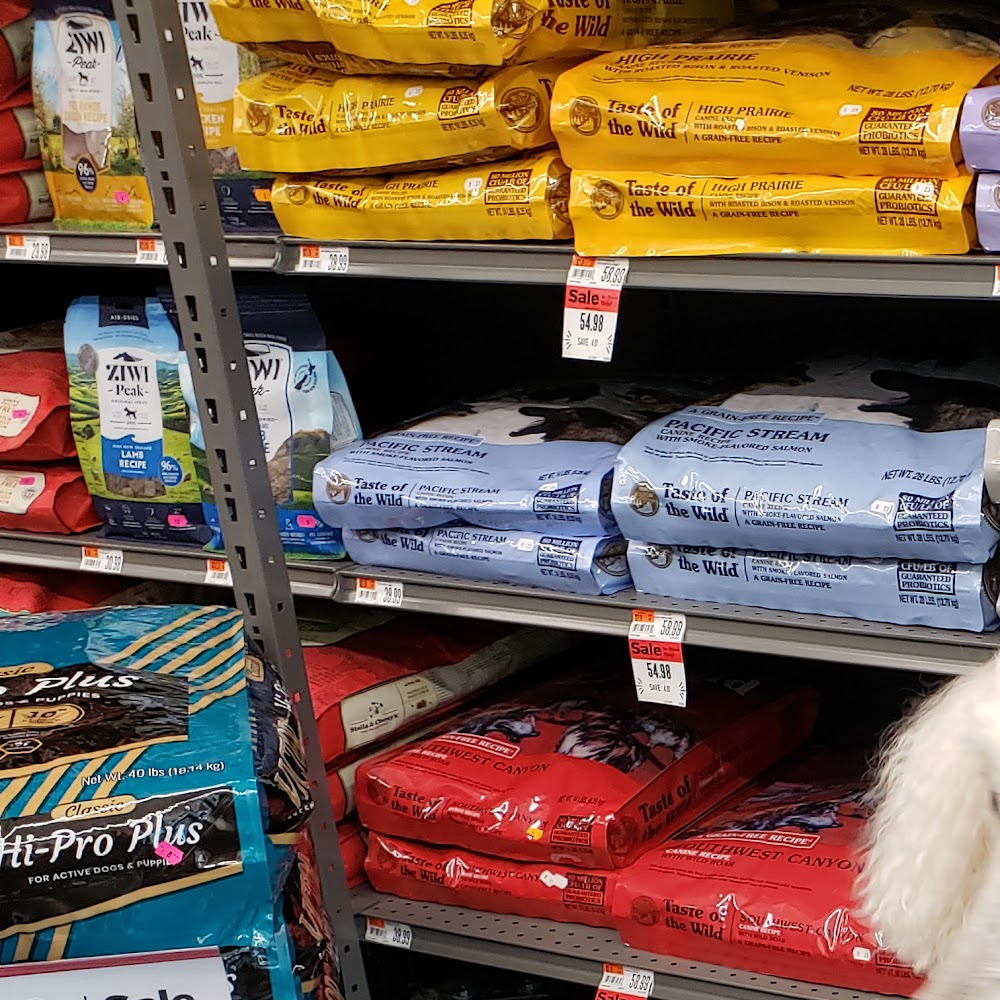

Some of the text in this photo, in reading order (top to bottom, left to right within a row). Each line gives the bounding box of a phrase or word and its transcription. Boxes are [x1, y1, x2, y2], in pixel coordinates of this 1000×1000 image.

[698, 105, 794, 119] HIGH PRAIRIE
[750, 181, 804, 190] PRAIRIE
[568, 290, 599, 305] Sale
[580, 313, 604, 332] 54.98
[106, 364, 150, 382] ZIWI
[115, 384, 144, 397] Peak
[746, 429, 830, 442] STREAM
[121, 451, 144, 459] LAMB
[119, 459, 147, 470] RECIPE
[418, 485, 457, 494] PACIFIC
[354, 492, 372, 505] the
[376, 494, 403, 506] Wild
[665, 504, 688, 518] the
[400, 537, 424, 551] Wild
[901, 574, 950, 582] GUARANTEED
[902, 582, 951, 591] PROBIOTICS
[631, 642, 662, 656] Sale
[646, 663, 672, 679] 54.98
[129, 761, 225, 778] 40 lbs kg)
[28, 863, 124, 884] FOR ACTIVE DOGS
[419, 869, 445, 885] Wild
[664, 899, 704, 919] Taste
[665, 917, 723, 941] the Wild
